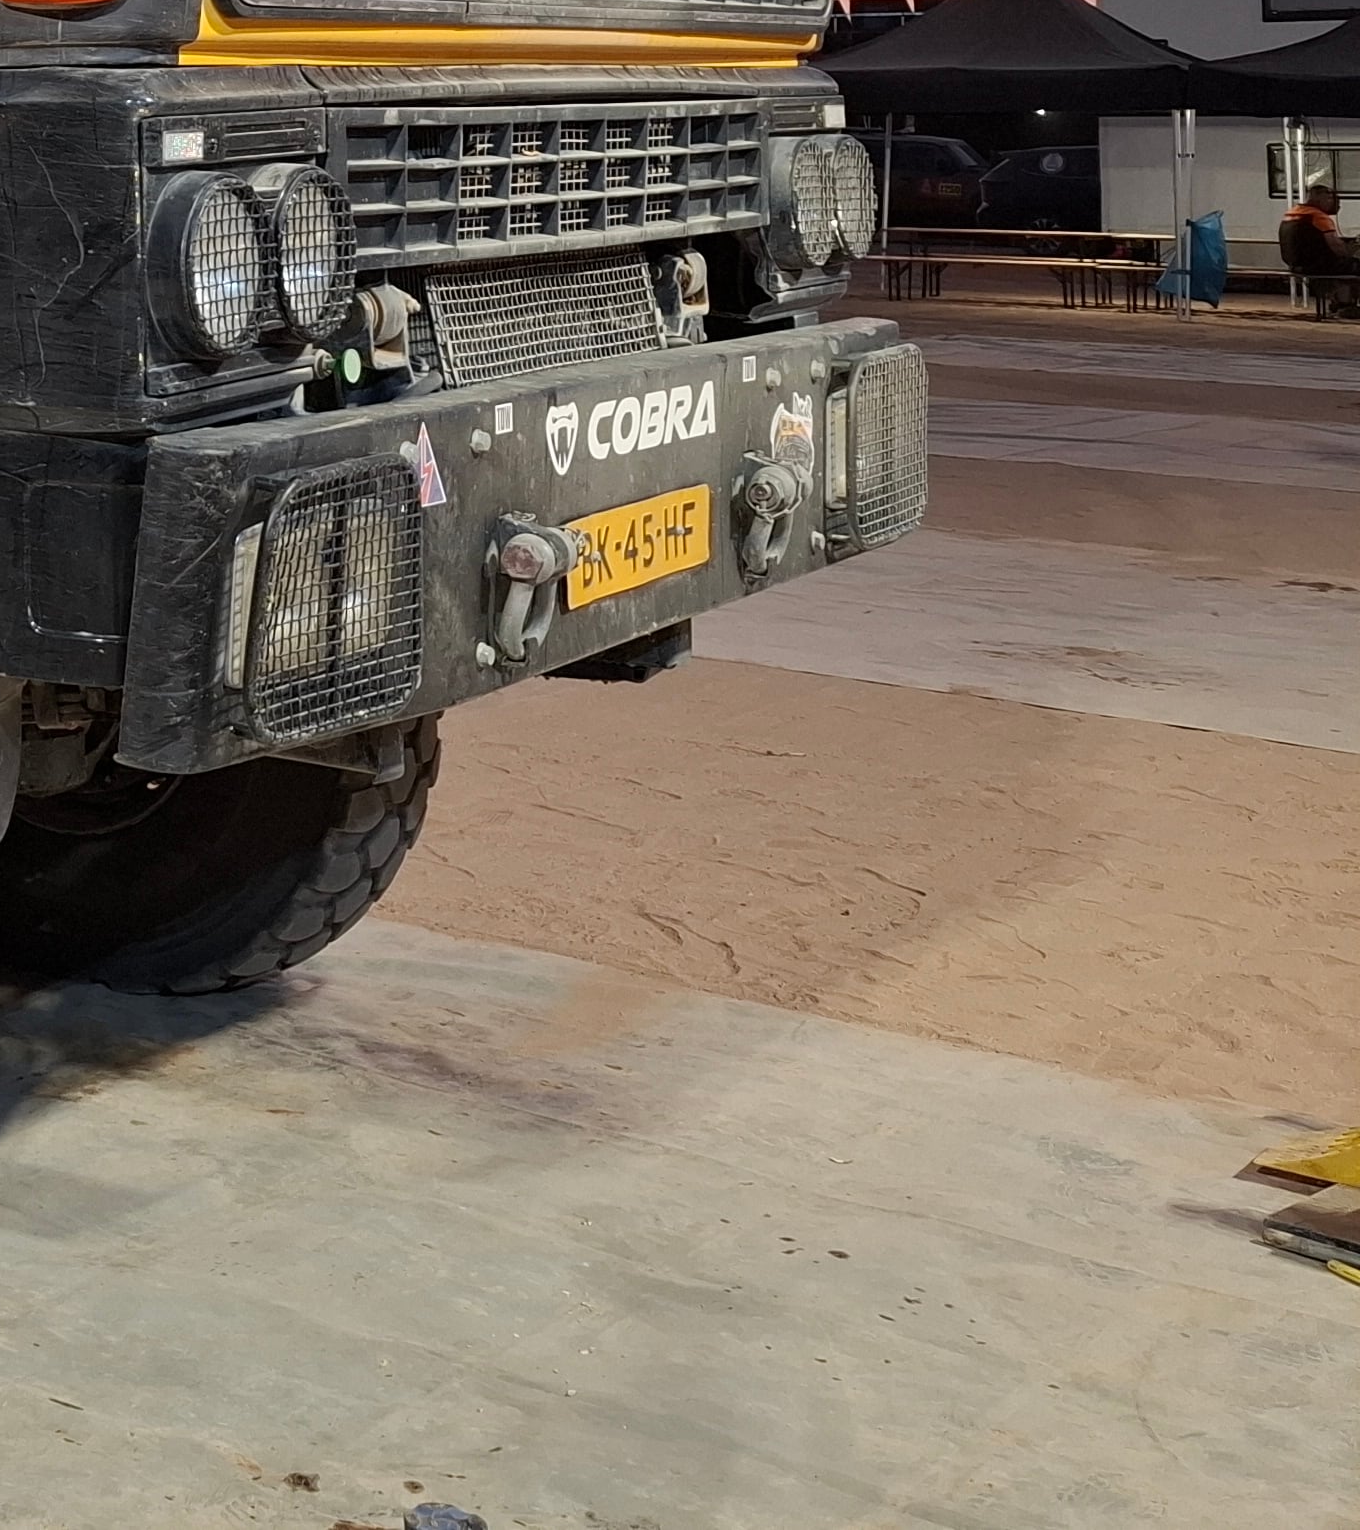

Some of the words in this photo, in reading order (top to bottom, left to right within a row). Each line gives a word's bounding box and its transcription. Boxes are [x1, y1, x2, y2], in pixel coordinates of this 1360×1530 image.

[496, 407, 512, 433] TOW
[587, 380, 716, 460] COBRA
[582, 501, 696, 588] BK-45-HF
